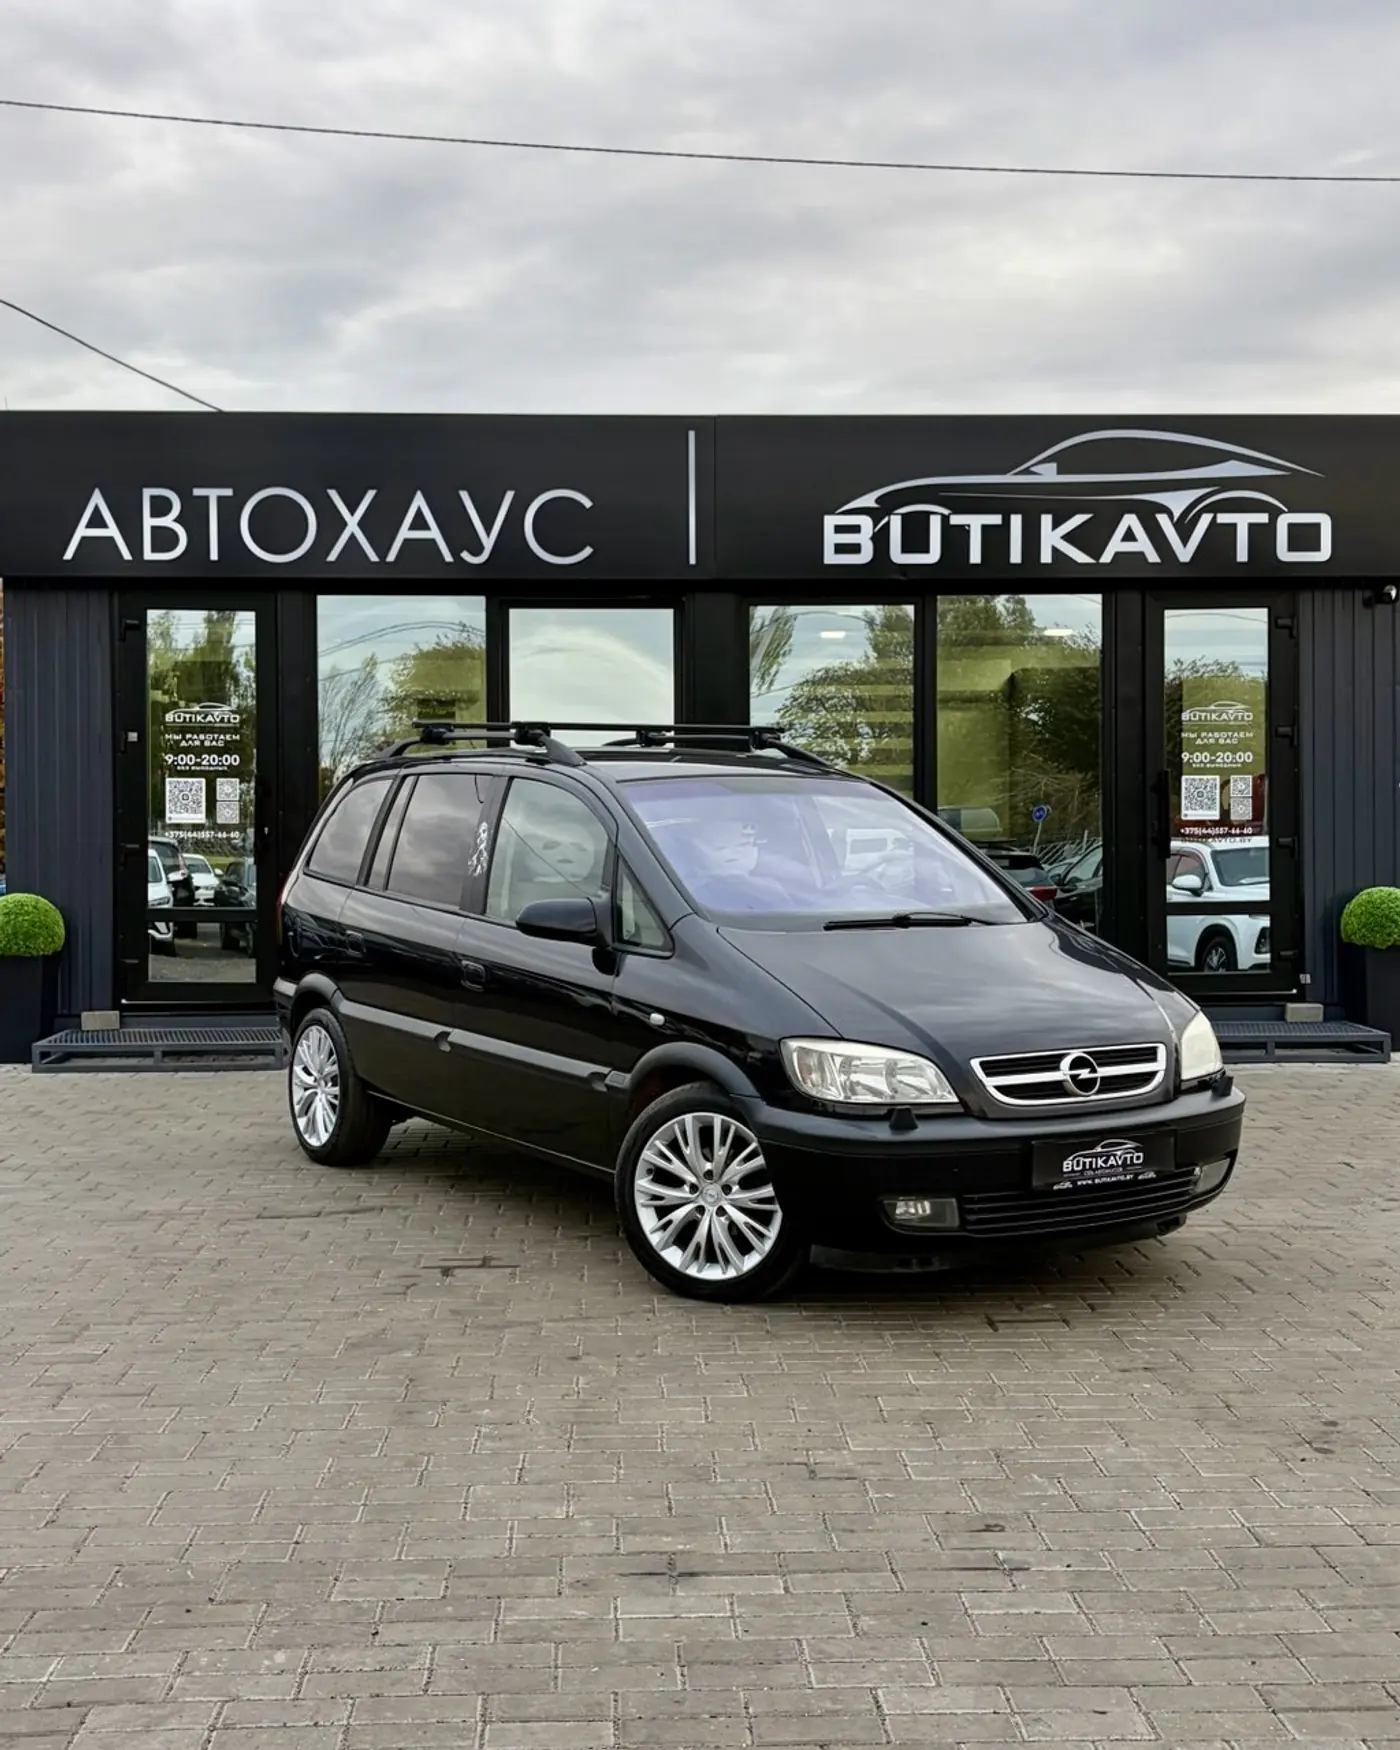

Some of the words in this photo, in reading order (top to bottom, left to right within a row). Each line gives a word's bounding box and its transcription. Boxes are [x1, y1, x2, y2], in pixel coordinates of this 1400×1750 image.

[63, 486, 594, 565] АВТОХАУС
[823, 512, 1333, 565] BUTIKAVTO
[165, 713, 240, 723] BUTIKAVTO
[1181, 711, 1254, 721] BUTIKAVTO
[185, 733, 241, 741] РАБОТАЕМ
[165, 754, 240, 766] 9:00-20:00
[1181, 751, 1254, 763] 9:00-20:00
[1063, 1152, 1144, 1172] BUTIKAVTO
